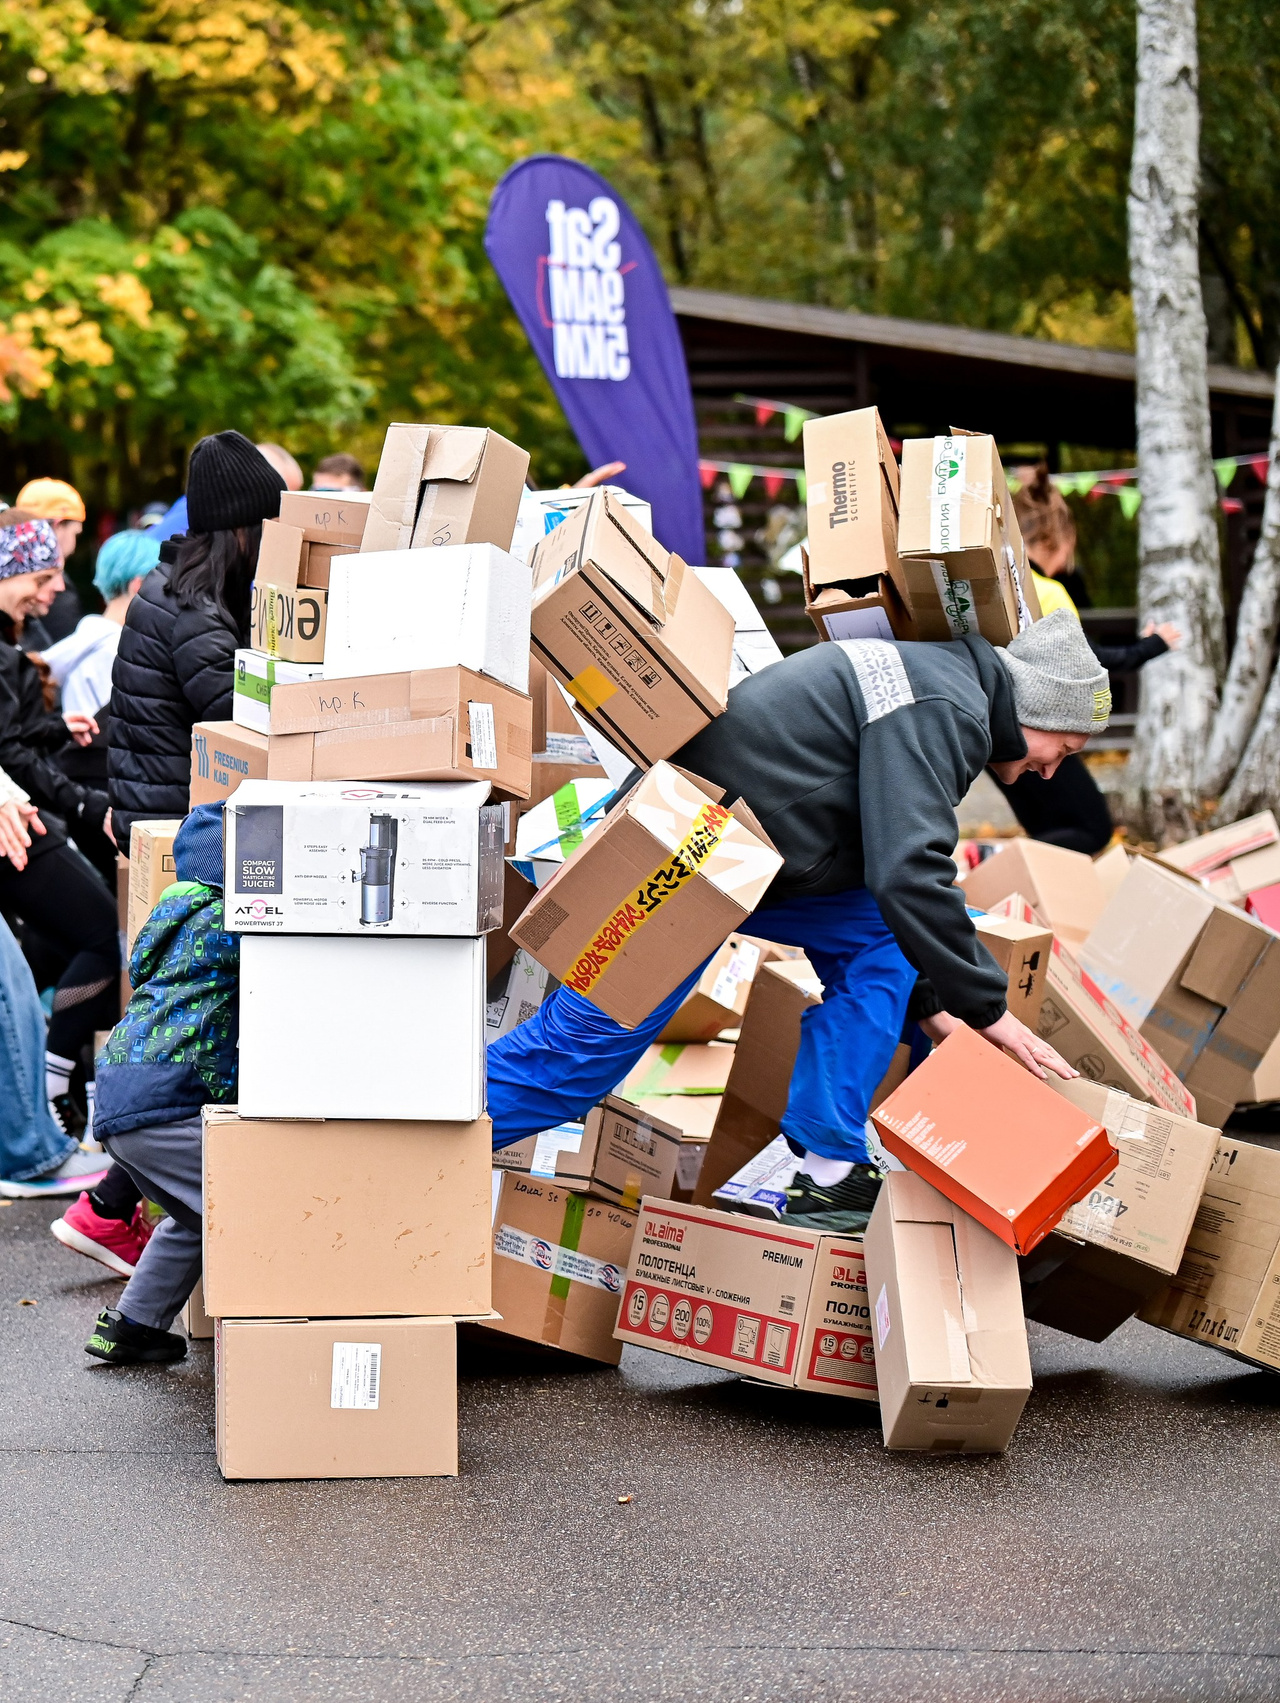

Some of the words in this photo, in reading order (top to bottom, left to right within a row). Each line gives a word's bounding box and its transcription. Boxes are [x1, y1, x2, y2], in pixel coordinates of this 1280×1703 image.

[830, 461, 848, 529] Thermo
[214, 750, 248, 775] FRESENIUS
[214, 769, 228, 787] KABI
[242, 867, 275, 875] SLOW
[235, 906, 283, 915] ATVEL
[652, 1222, 684, 1243] Laima
[642, 1237, 681, 1252] PROFESSIONAL
[1118, 1237, 1133, 1248] SFM
[638, 1253, 696, 1278] ПОЛОТЕНЦА
[762, 1250, 803, 1268] PREMIUM
[636, 1269, 670, 1285] БУМАЖНЫЕ
[671, 1278, 705, 1293] ЛИСТОВЫЕ
[715, 1289, 750, 1305] СЛОЖЕНИЯ
[633, 1294, 644, 1310] 15
[675, 1309, 690, 1322] 200
[696, 1317, 711, 1328] 100%
[823, 1318, 863, 1330] БУМАЖНЫЕ
[1217, 1319, 1227, 1337] 6
[1223, 1326, 1239, 1343] шт.
[823, 1338, 834, 1347] 15
